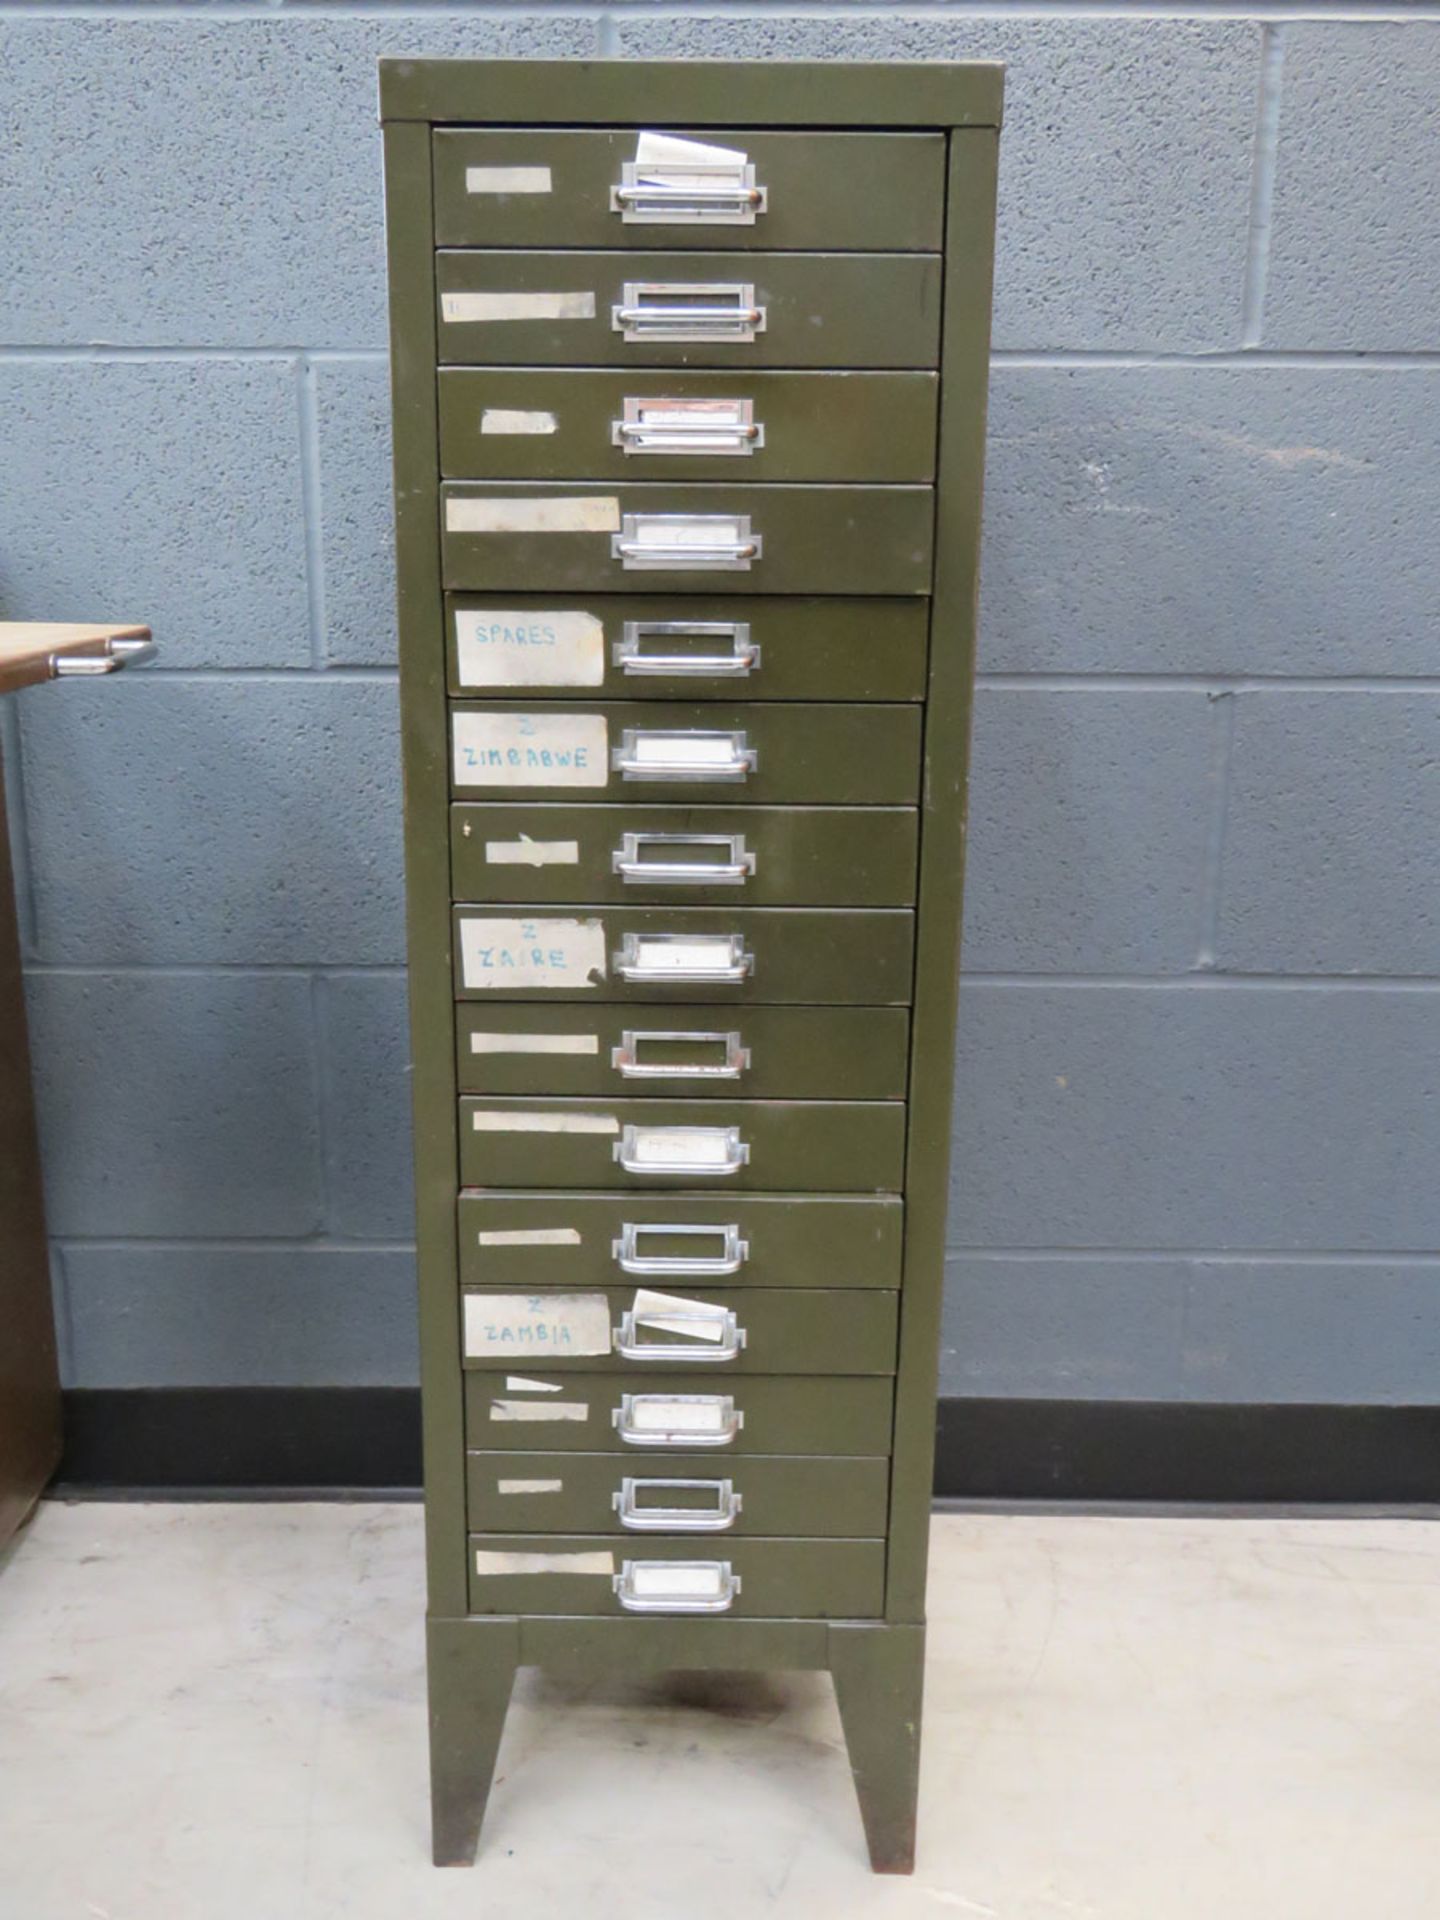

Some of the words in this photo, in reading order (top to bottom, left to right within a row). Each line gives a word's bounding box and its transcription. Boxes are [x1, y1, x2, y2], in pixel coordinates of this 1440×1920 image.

[475, 624, 556, 645] SPARES
[517, 716, 536, 735] Z
[463, 747, 588, 767] ZIMBABWE
[521, 924, 537, 939] Z
[528, 1297, 543, 1313] Z
[484, 1323, 571, 1344] ZAMBIA
